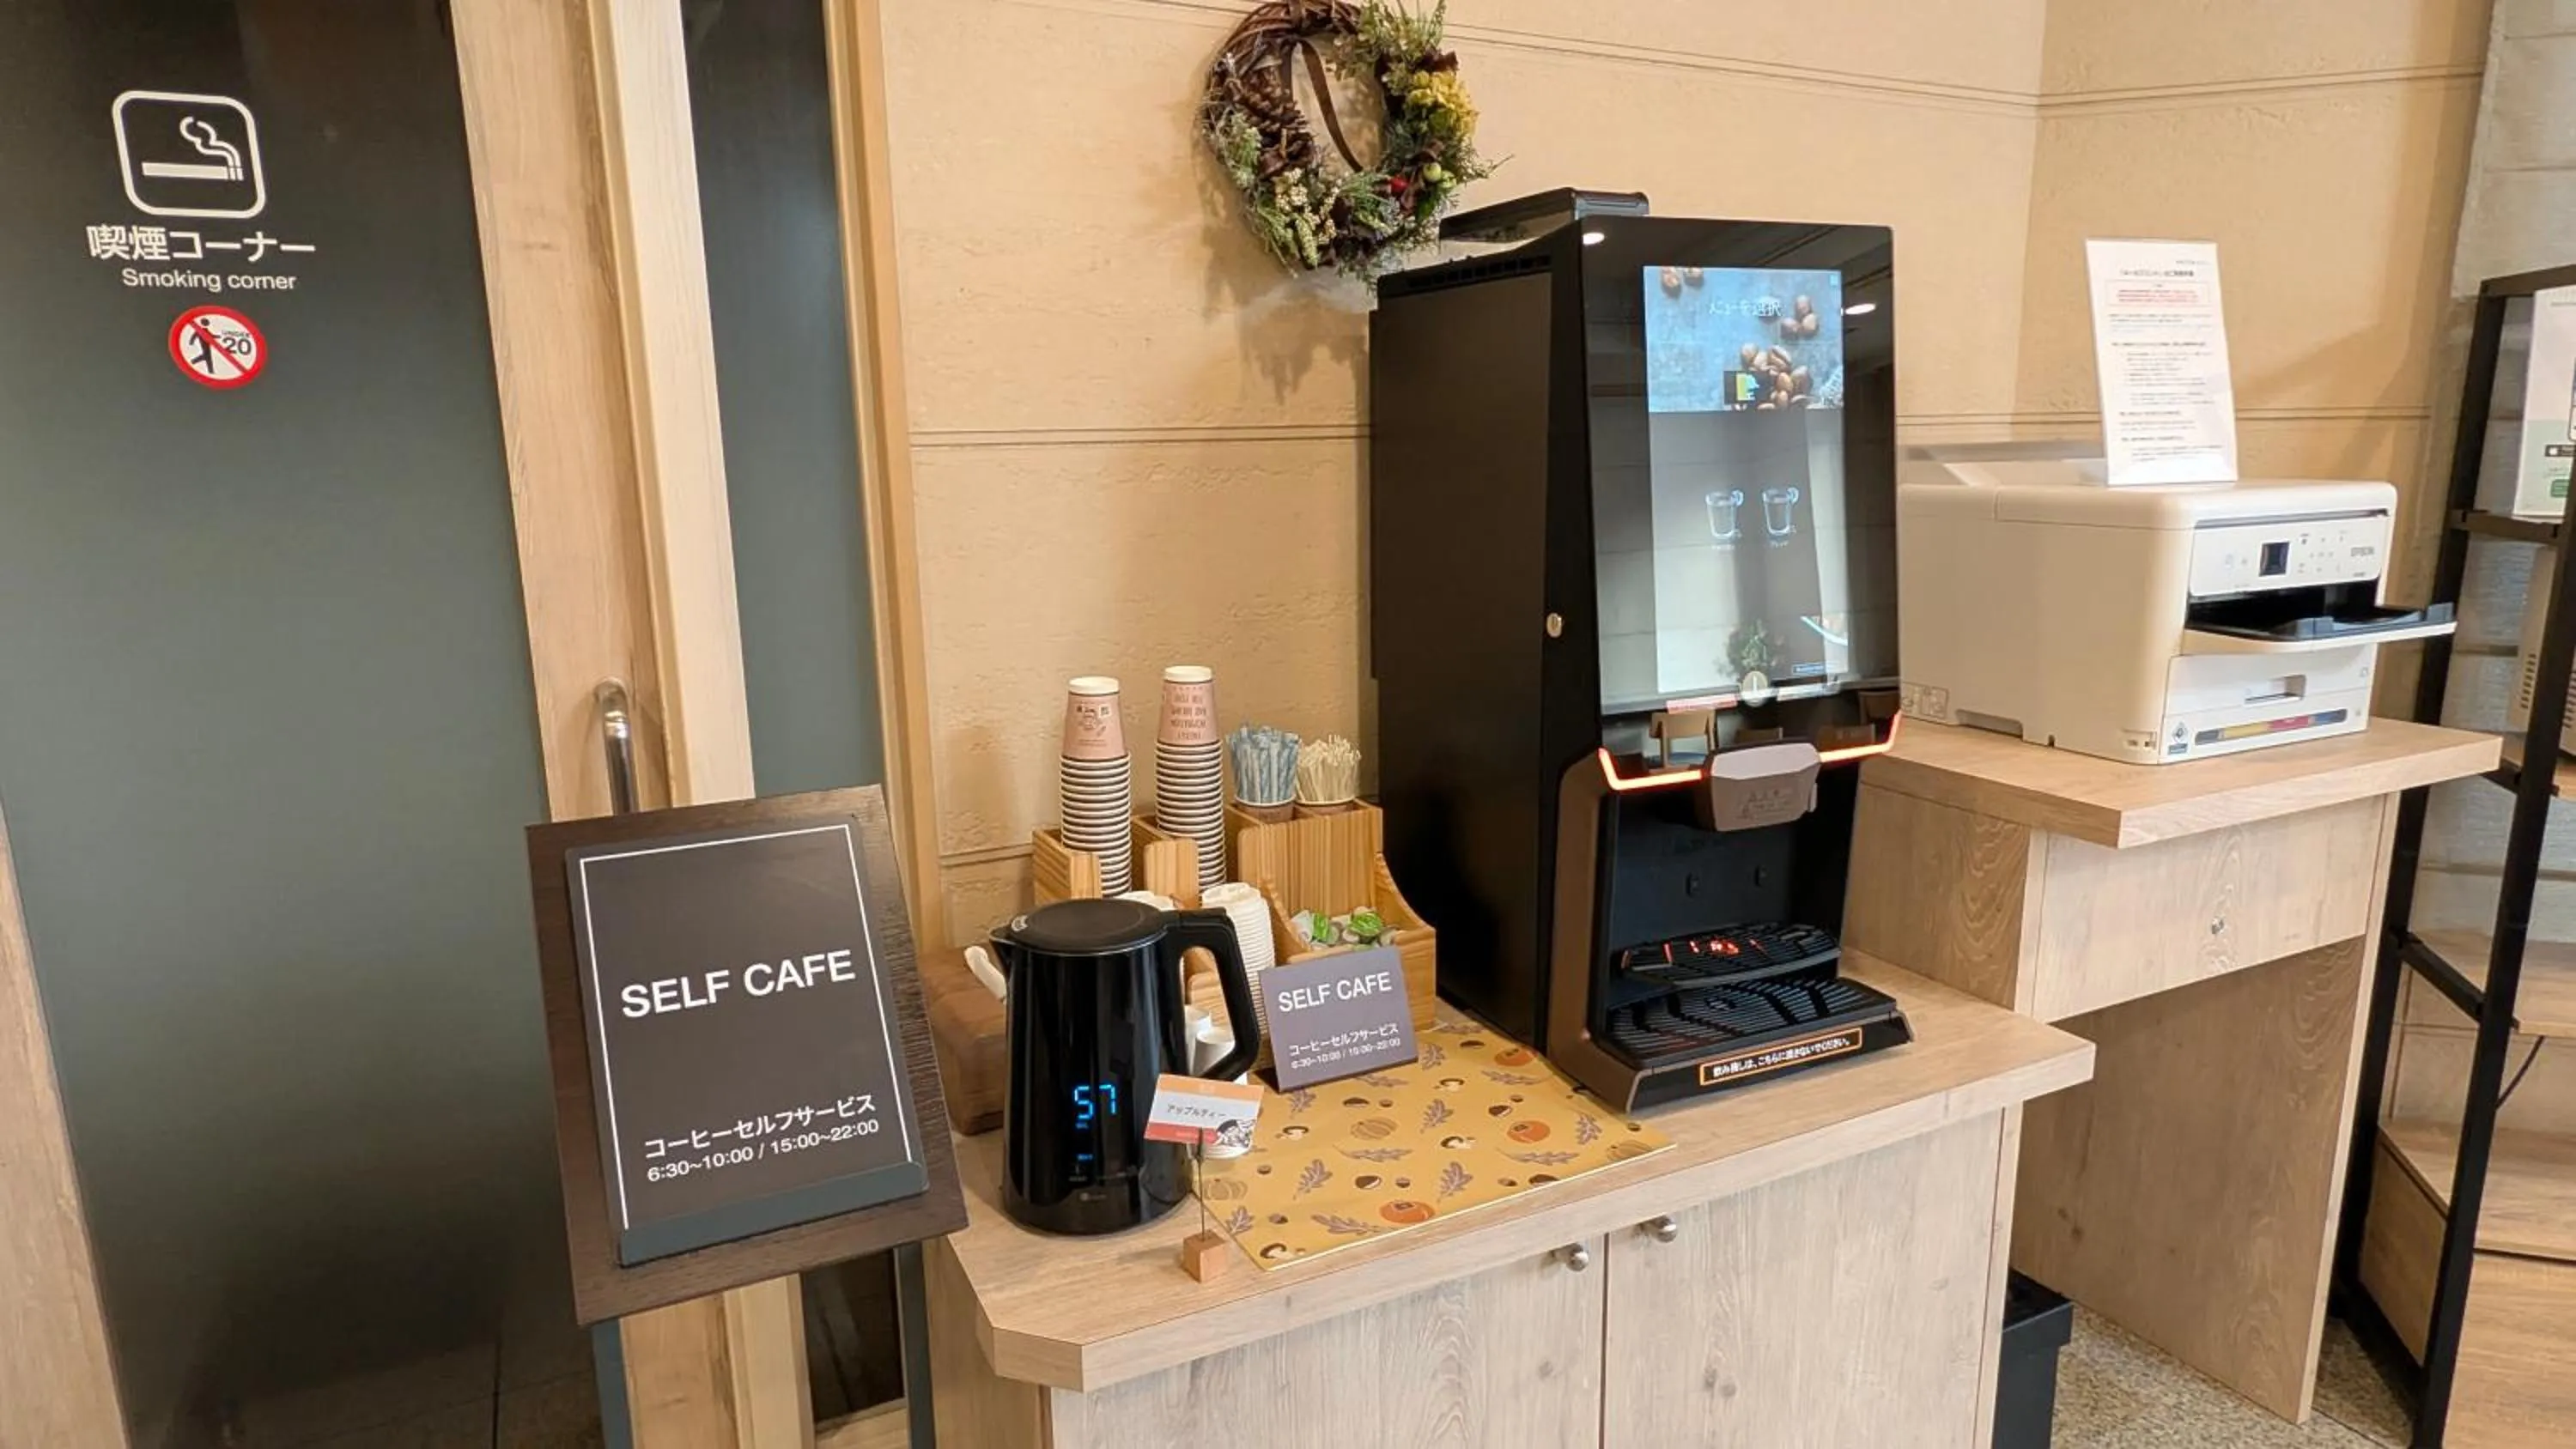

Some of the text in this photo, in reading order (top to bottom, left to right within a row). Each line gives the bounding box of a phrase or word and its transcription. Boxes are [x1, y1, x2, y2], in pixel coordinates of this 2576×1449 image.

[86, 224, 316, 262] 喫煙コーナー
[122, 268, 297, 292] Smoking corner
[222, 336, 252, 355] 20
[621, 949, 856, 1017] SELF CAFE
[1278, 972, 1392, 1012] SELF CAFE
[1289, 1022, 1399, 1057] コーヒーセルフサービス
[1073, 1083, 1118, 1121] 57
[1166, 1103, 1226, 1118] アップルティー
[644, 1094, 875, 1159] コーヒーセルフサービス
[647, 1145, 754, 1182] 6:30~10:00
[770, 1119, 879, 1155] 15:00~22:00
